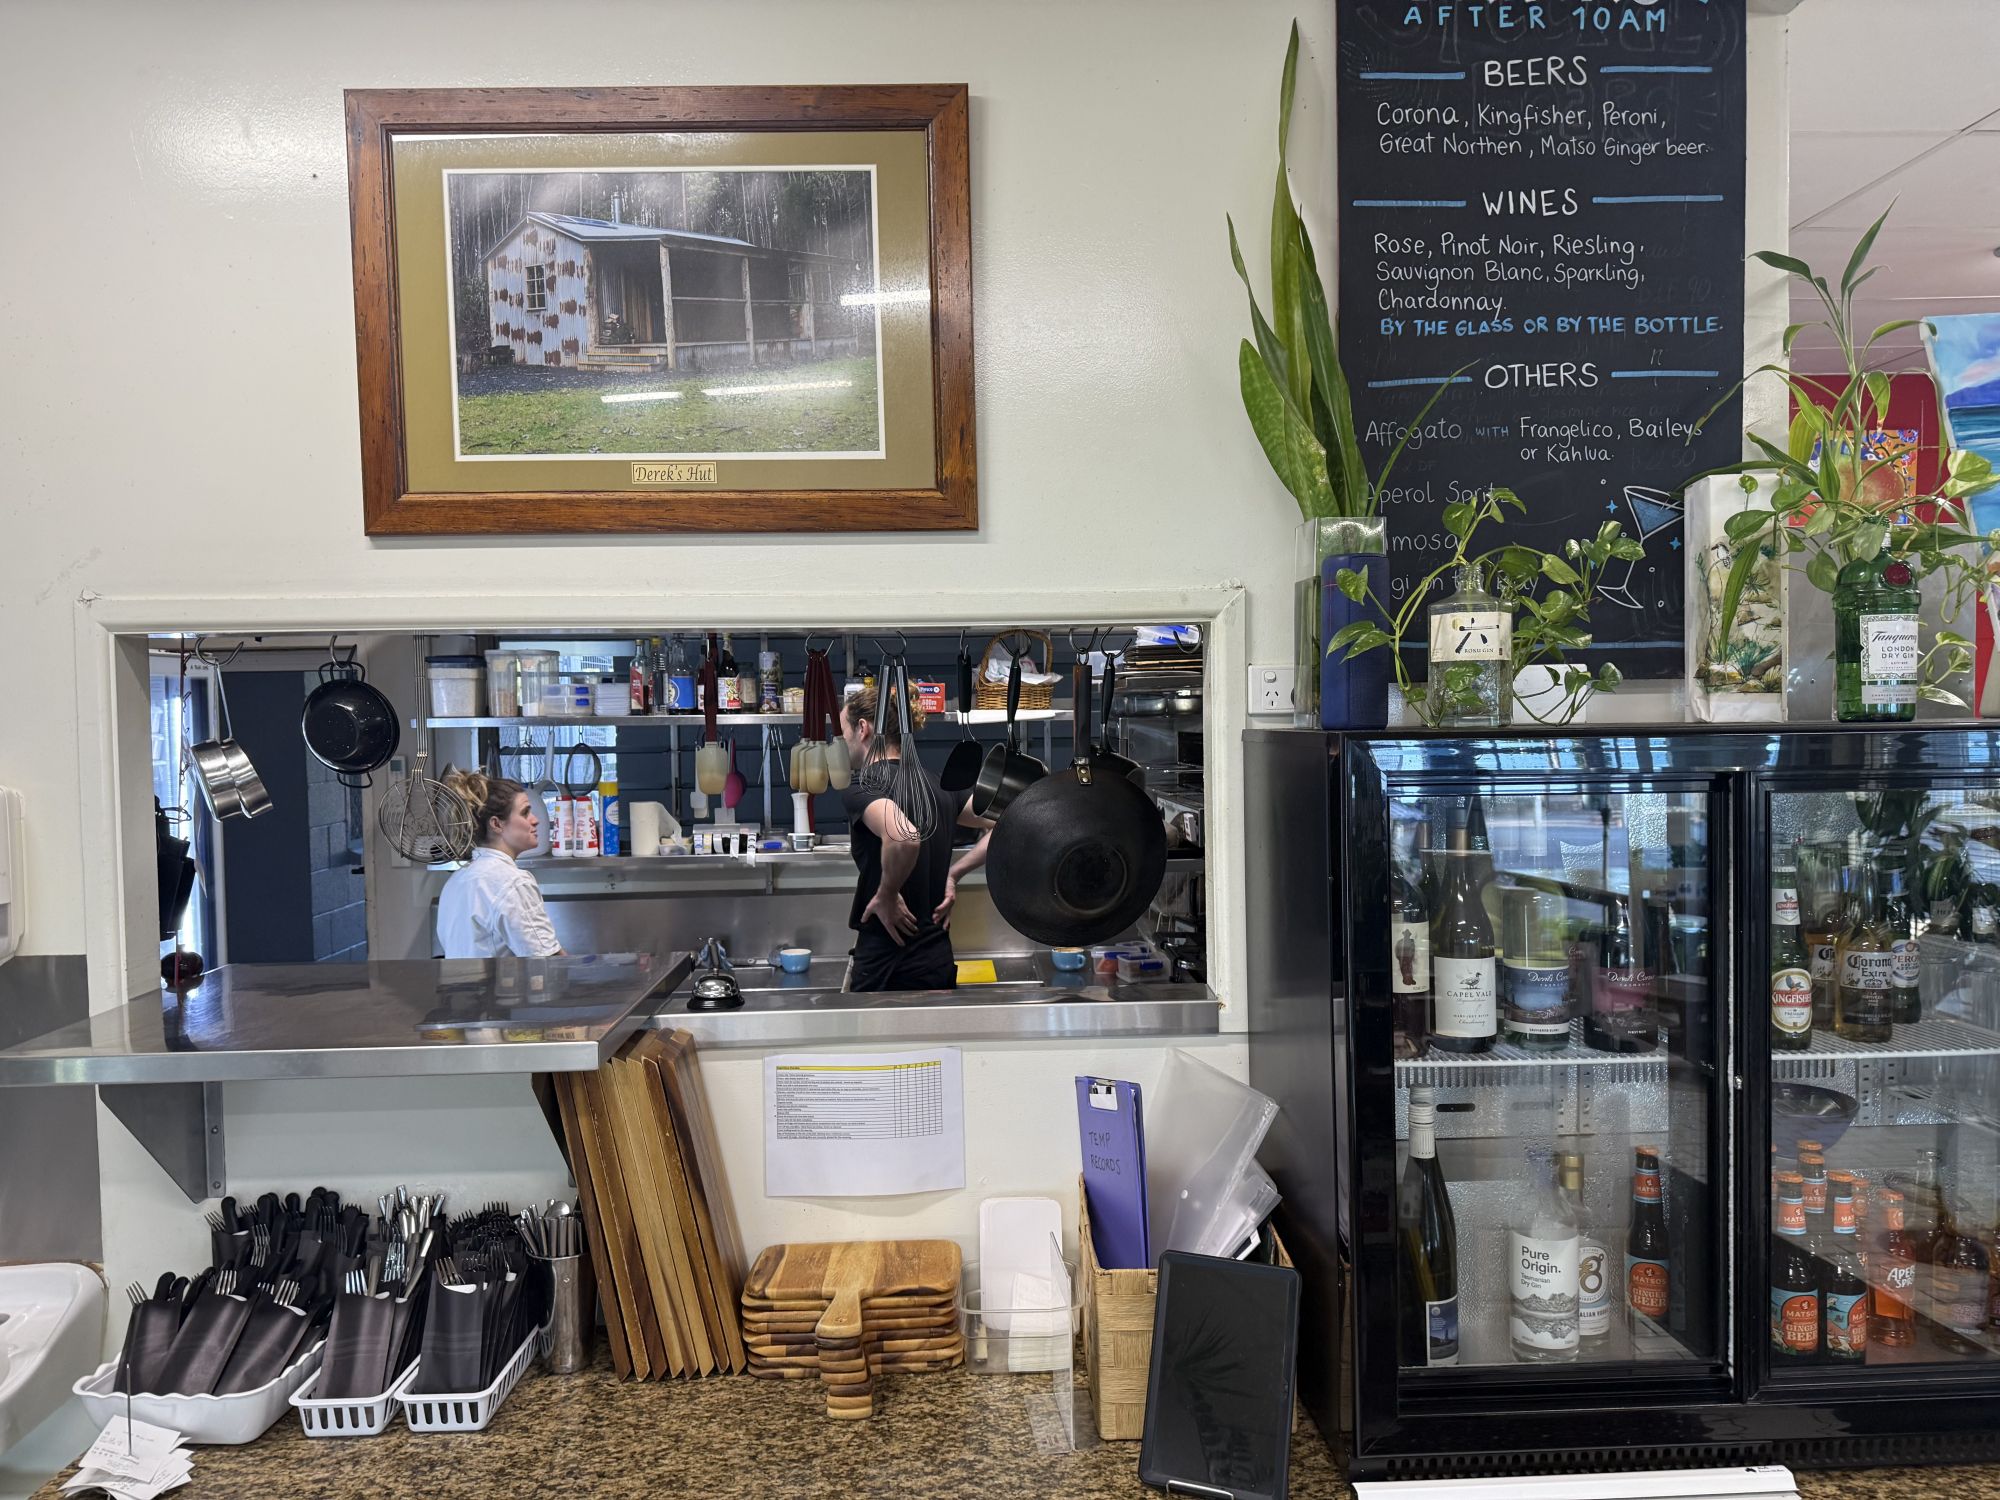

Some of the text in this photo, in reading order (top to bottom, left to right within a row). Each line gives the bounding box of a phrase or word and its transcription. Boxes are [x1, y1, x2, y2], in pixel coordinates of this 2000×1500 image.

[1403, 5, 1666, 32] AFTER 10AM
[1483, 56, 1588, 87] BEERS
[1377, 101, 1666, 136] Corona, Kingfisher, Peroni,
[1379, 131, 1436, 154] Great
[1541, 135, 1596, 157] Matso
[1603, 138, 1661, 166] Ginger
[1482, 188, 1579, 217] WINES
[1374, 231, 1645, 265] Rose, Pinot Noir, Riesling,
[1376, 260, 1646, 291] Sauvignon Blanc, Sparkling,
[1378, 287, 1507, 321] Chardonnay.
[1380, 315, 1724, 337] BY THE GLASS OR BY THE BOTTLE.
[1483, 362, 1599, 390] OTHERS
[1364, 417, 1463, 450] Affogato
[1475, 425, 1510, 438] WITH
[1519, 416, 1622, 449] Frangelico,
[1520, 447, 1538, 461] or
[635, 464, 713, 481] Derek's Hut
[1861, 967, 1887, 979] Extra
[1446, 990, 1474, 998] CAPEL
[1088, 1130, 1111, 1149] TEMP
[1090, 1154, 1121, 1176] RECORDS
[1521, 1245, 1550, 1261] Pure
[1521, 1258, 1562, 1275] Origin.
[1521, 1272, 1551, 1283] Tasmanian
[1520, 1278, 1530, 1288] Dry
[1632, 1288, 1667, 1299] GINGER
[1633, 1296, 1667, 1307] BEER
